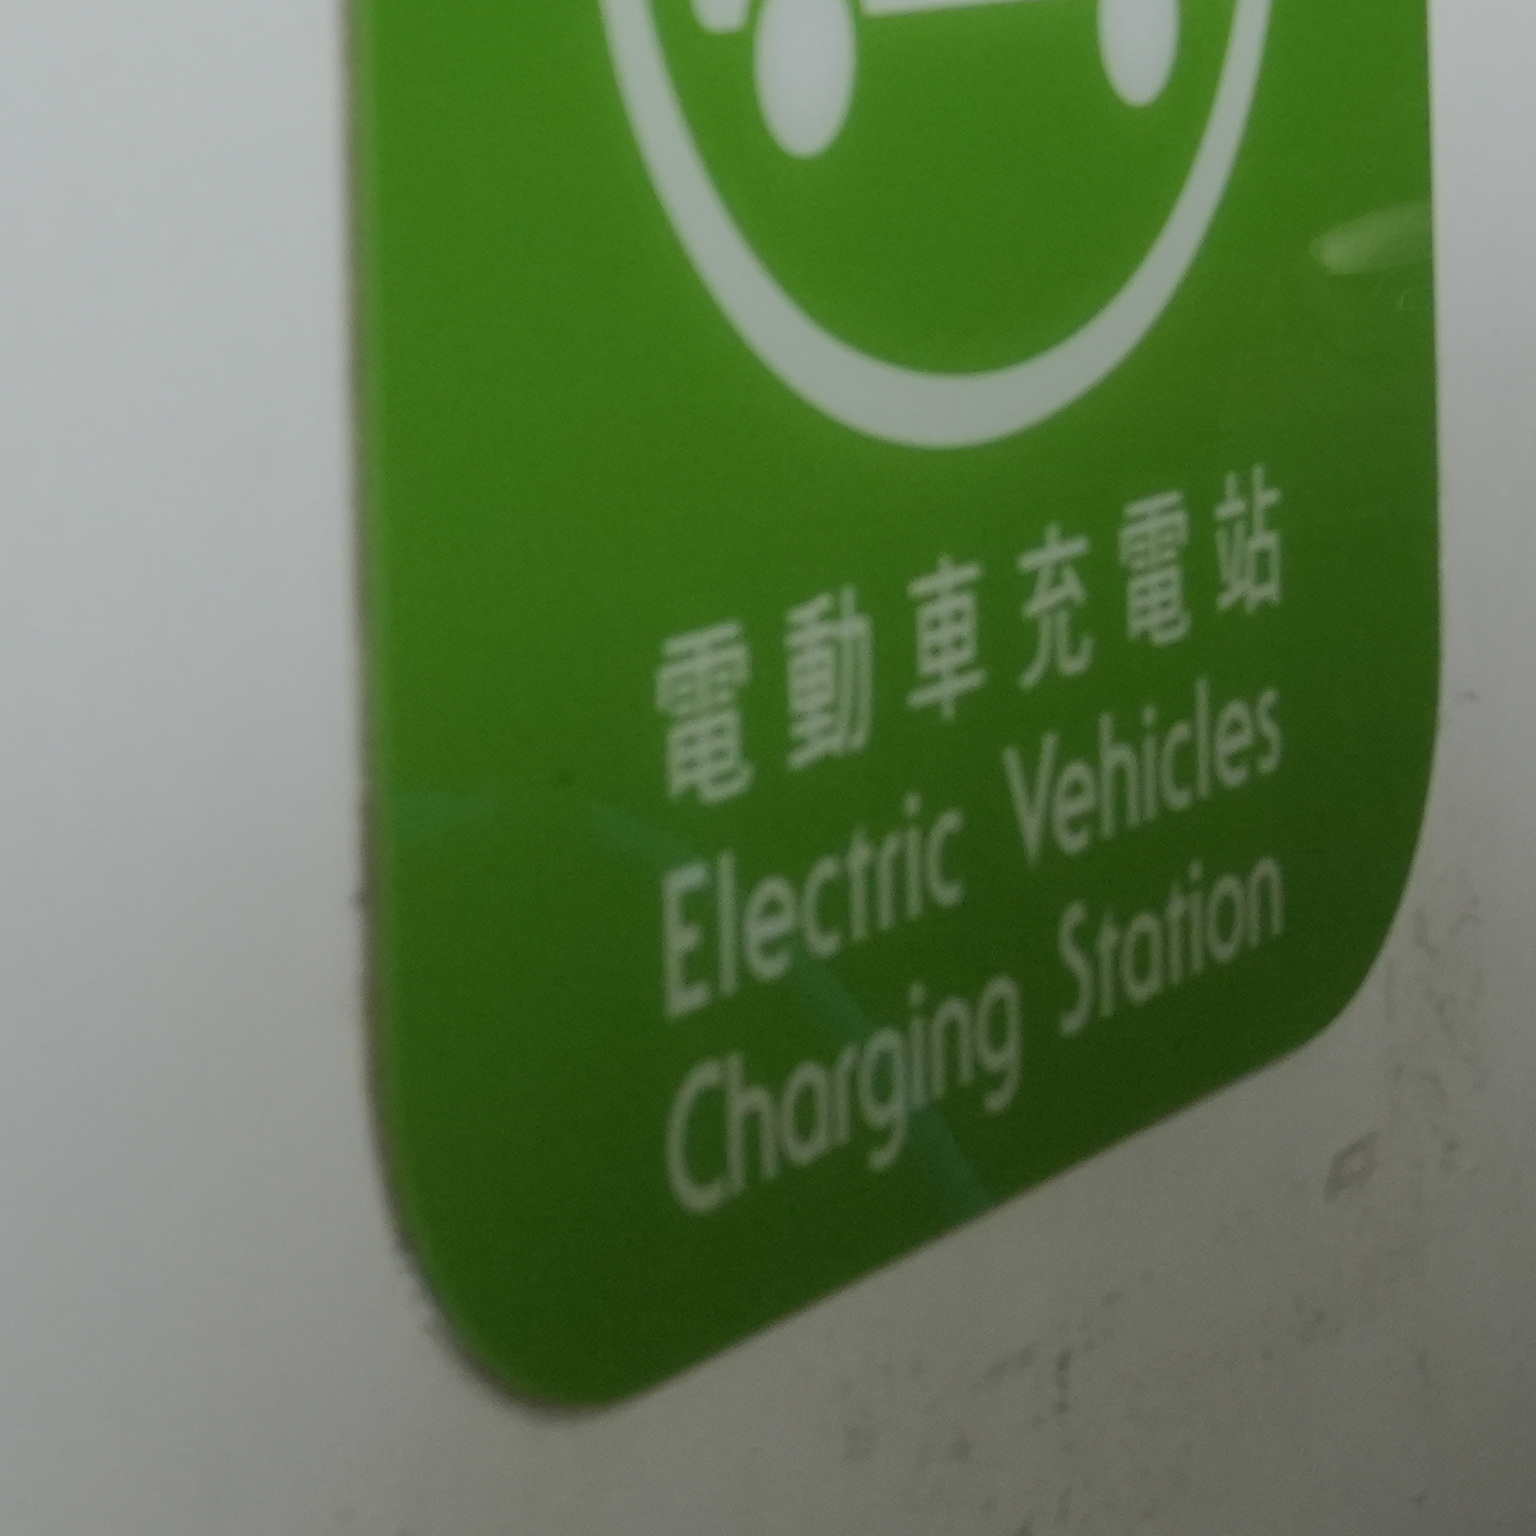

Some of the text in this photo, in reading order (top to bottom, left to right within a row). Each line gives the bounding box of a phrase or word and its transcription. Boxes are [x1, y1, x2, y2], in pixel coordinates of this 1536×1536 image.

[655, 465, 1283, 806] 電動車充電站
[661, 675, 1284, 1020] Electric Vehicles
[665, 856, 1284, 1215] Charging Station
